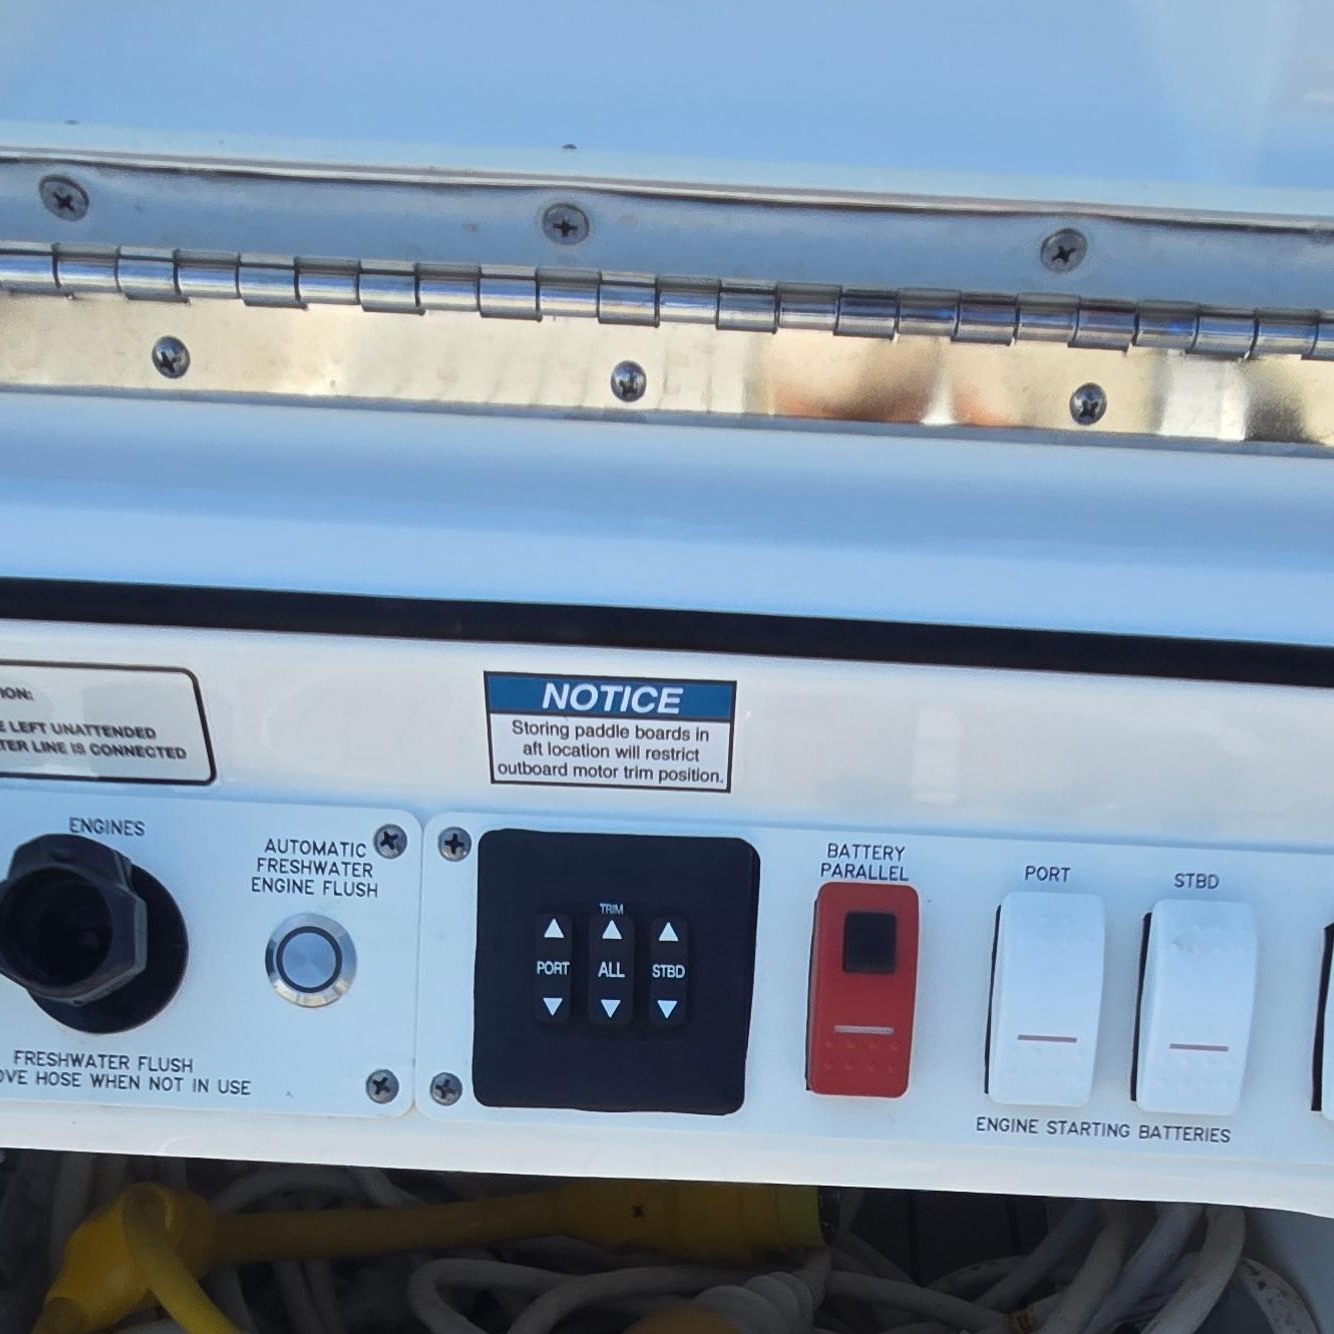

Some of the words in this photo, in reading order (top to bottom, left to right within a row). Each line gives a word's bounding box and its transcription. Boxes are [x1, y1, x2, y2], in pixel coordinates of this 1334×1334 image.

[542, 682, 684, 715] NOTICE
[8, 720, 47, 734] LEFT
[50, 722, 157, 740] UNATTENDED
[512, 719, 569, 740] Storing
[575, 722, 630, 741] paddle
[635, 724, 690, 741] boards
[695, 726, 710, 742] in
[31, 740, 66, 754] LINE
[69, 742, 87, 755] IS
[89, 743, 187, 760] CONNECTED
[523, 741, 543, 756] aft
[548, 742, 610, 759] location
[616, 744, 640, 760] will
[645, 746, 700, 762] restrict
[498, 762, 568, 777] outboard
[573, 764, 618, 779] motor
[624, 766, 653, 781] trim
[658, 768, 724, 785] position.
[69, 816, 145, 837] ENGINES
[265, 838, 367, 858] AUTOMATIC
[827, 843, 905, 862] BATTERY
[257, 857, 373, 878] FRESHWATER
[820, 863, 909, 882] PARALLEL
[1025, 865, 1071, 882] PORT
[251, 876, 315, 895] ENGINE
[323, 880, 378, 898] FLUSH
[1174, 873, 1220, 890] STBD
[599, 903, 624, 915] TRIM
[537, 961, 570, 975] PORT
[598, 961, 625, 978] ALL
[652, 964, 685, 979] STBD
[14, 1050, 130, 1070] FRESHWATER
[138, 1056, 193, 1073] FLUSH
[36, 1071, 81, 1087] HOSE
[90, 1073, 140, 1090] WHEN
[149, 1076, 184, 1092] NOT
[192, 1078, 210, 1093] IN
[218, 1079, 251, 1095] USE
[976, 1117, 1039, 1135] ENGINE
[1047, 1120, 1130, 1138] STARTING
[1138, 1124, 1232, 1143] BATTERIES
